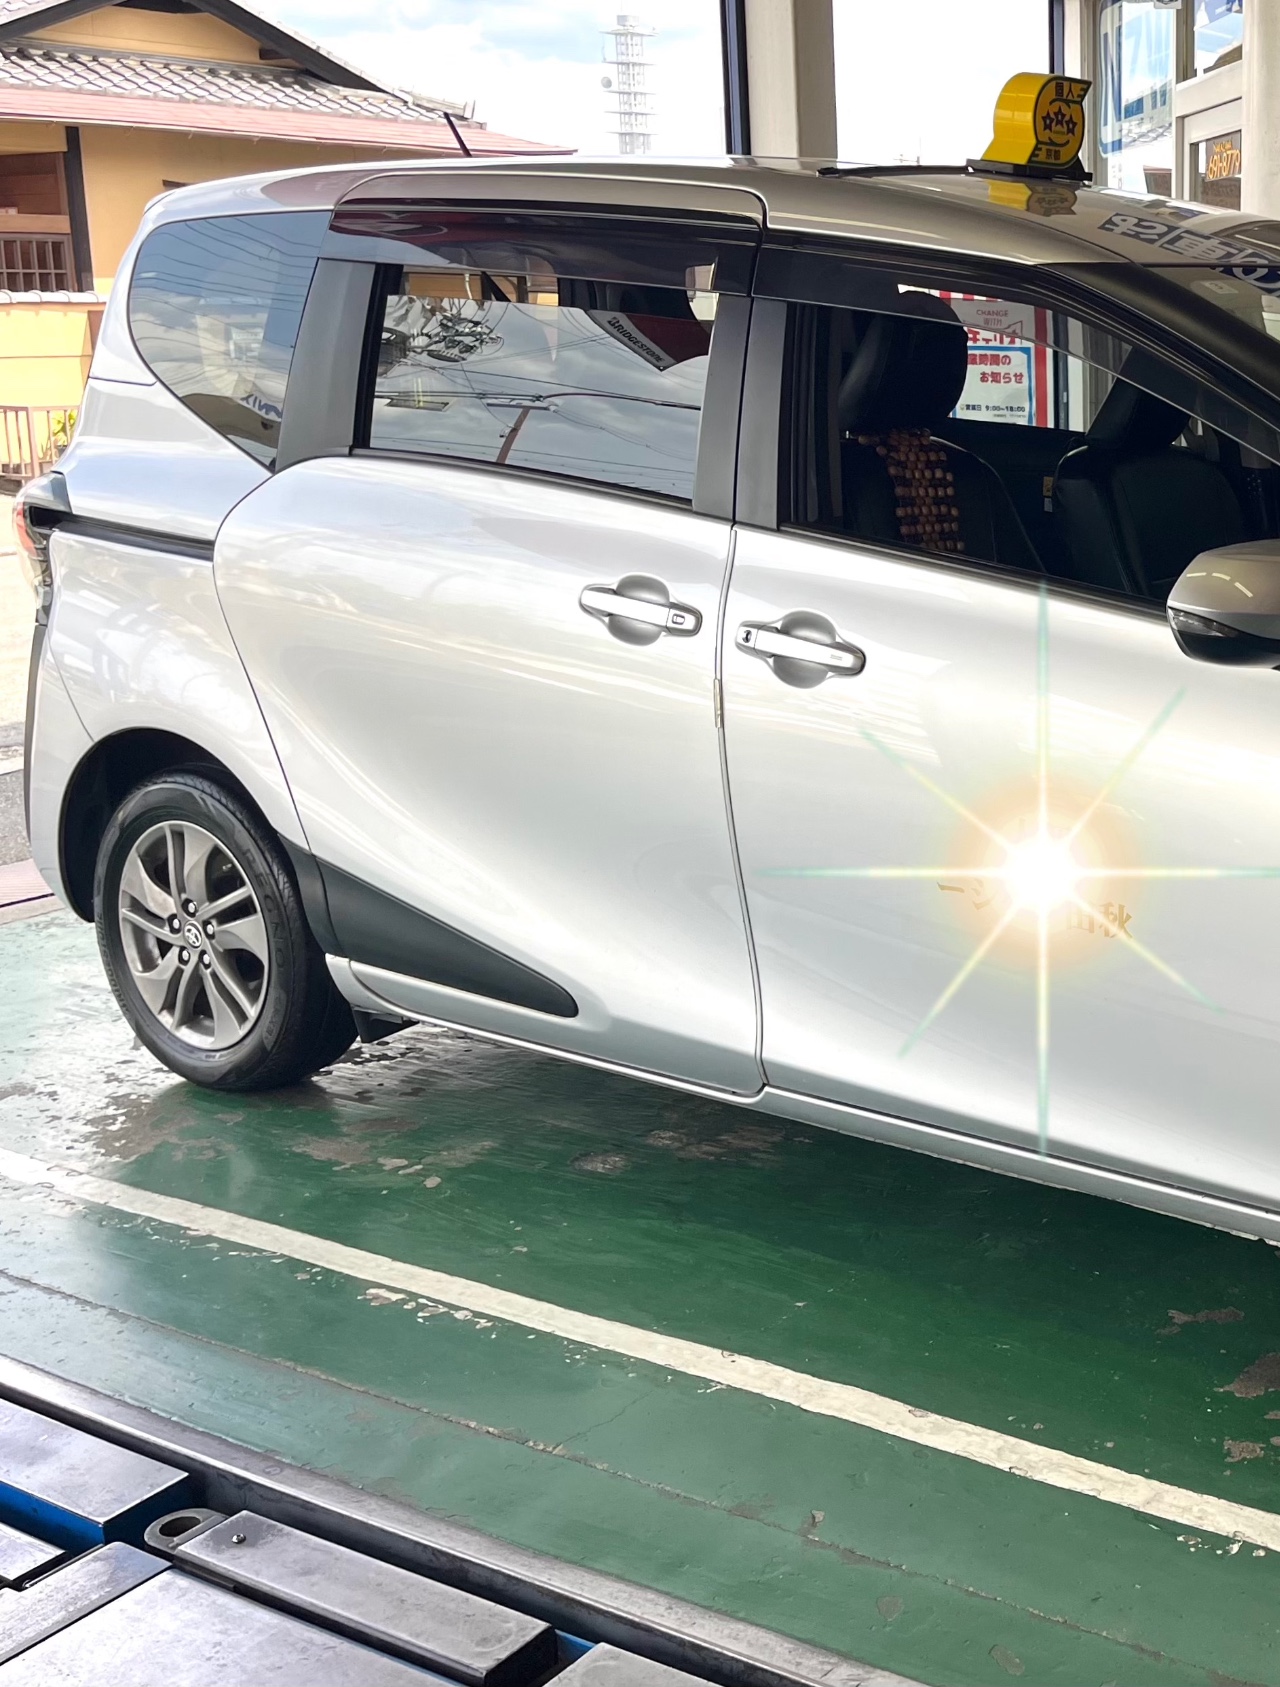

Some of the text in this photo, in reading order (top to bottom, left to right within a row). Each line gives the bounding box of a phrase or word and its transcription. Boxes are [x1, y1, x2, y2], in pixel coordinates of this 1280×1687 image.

[976, 309, 1009, 317] CHANGE
[607, 316, 665, 363] BRIDGESTONE
[979, 371, 1024, 385] お知らせ
